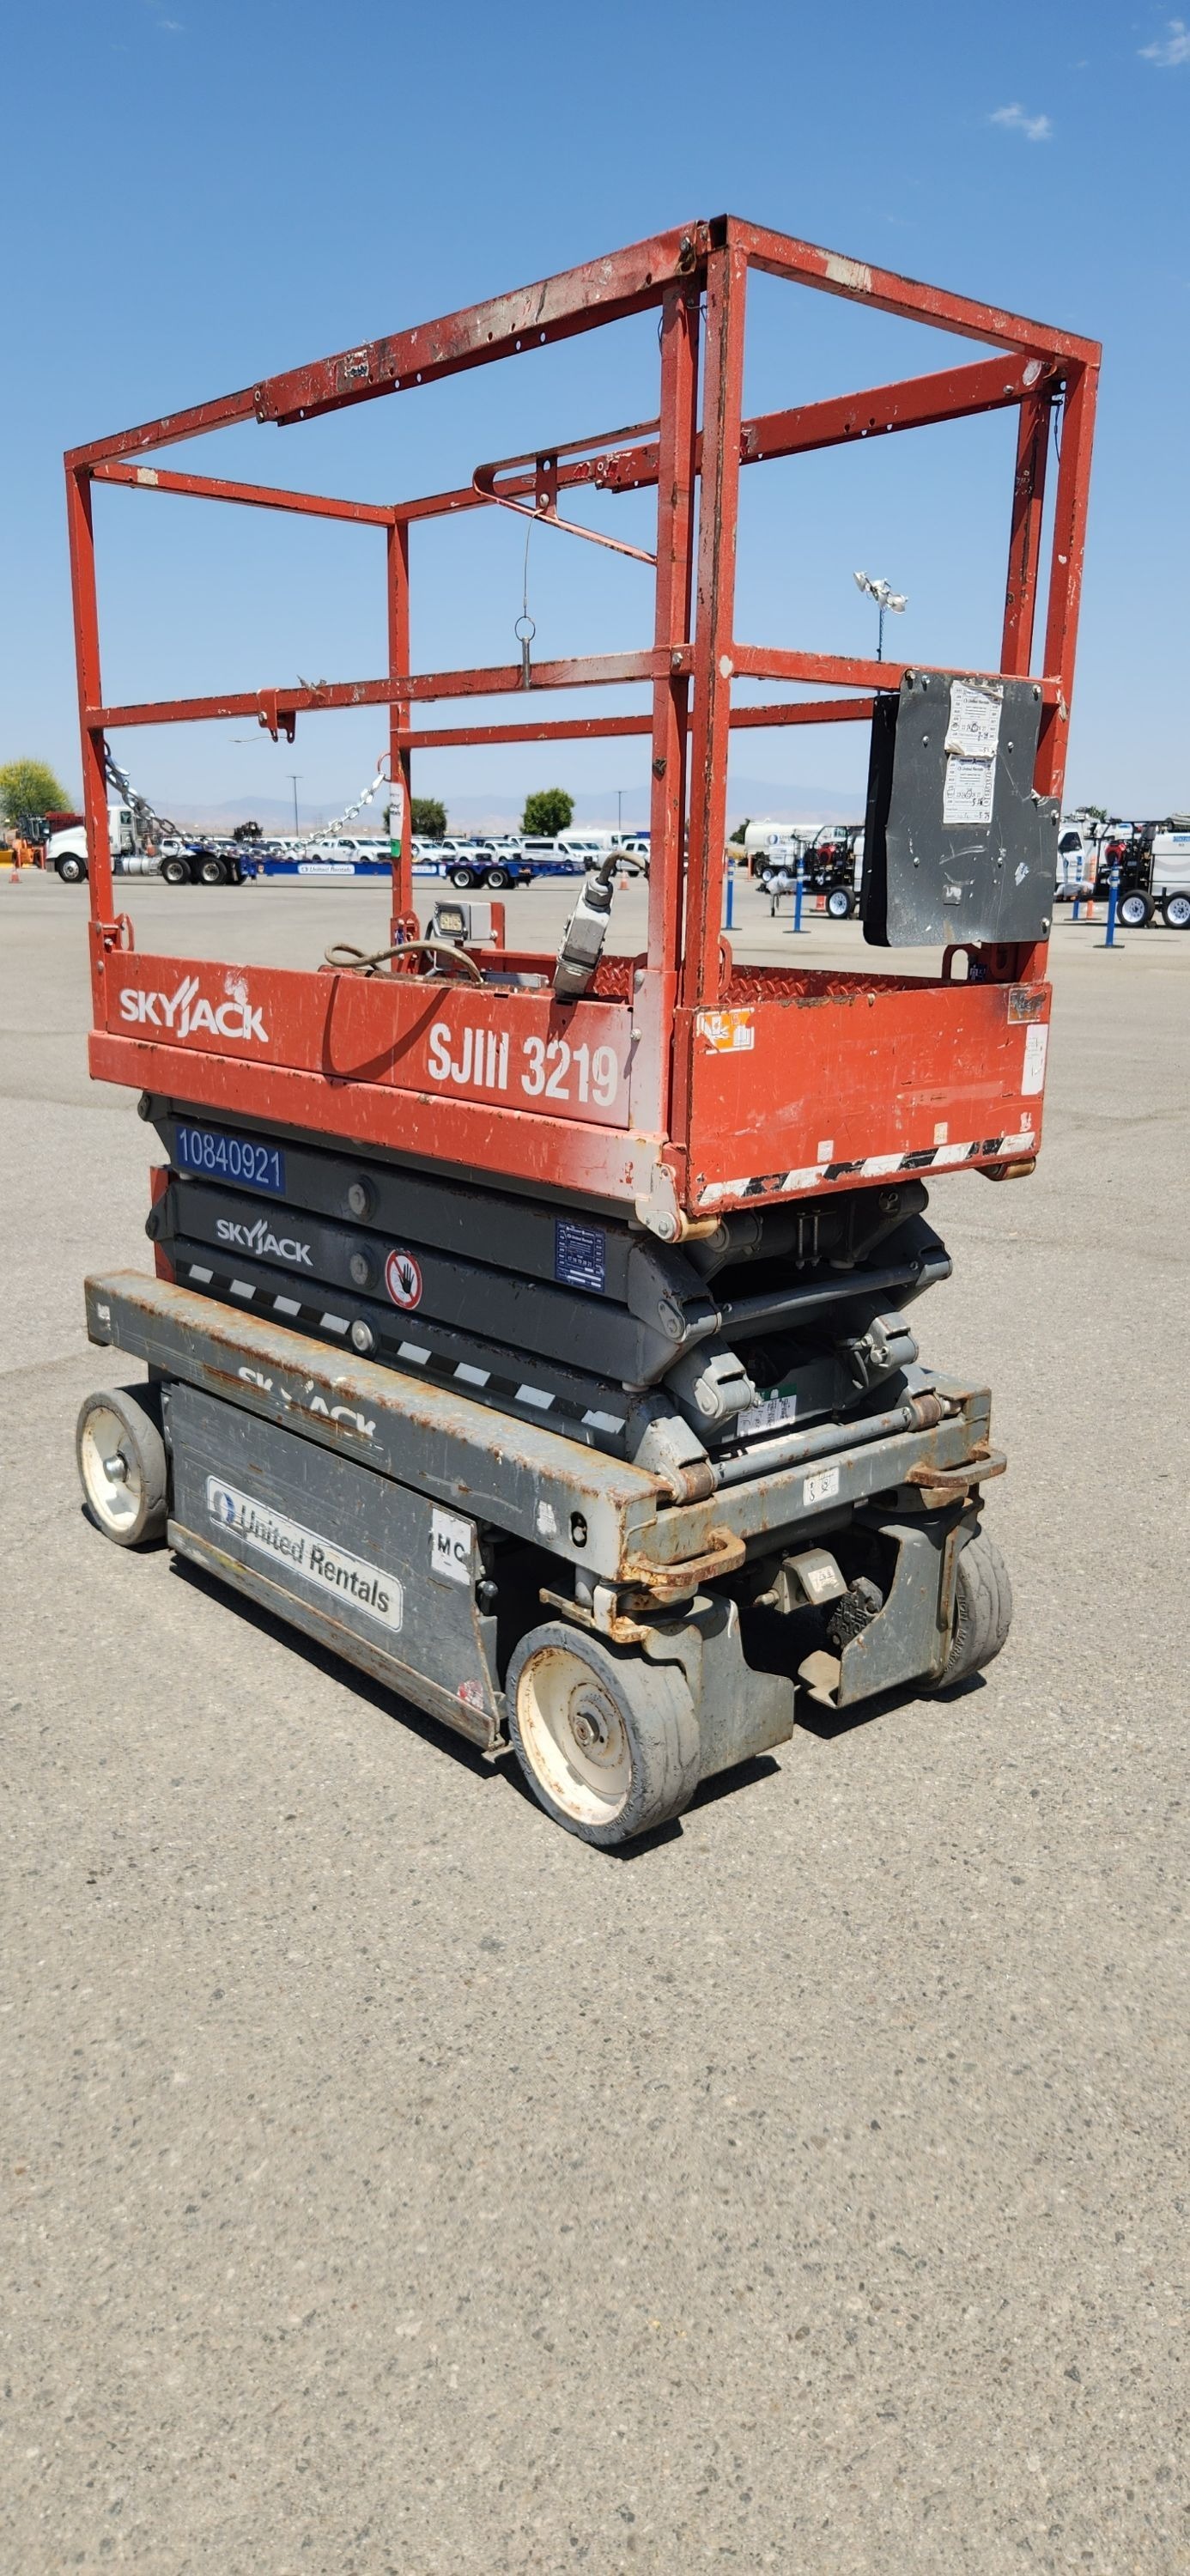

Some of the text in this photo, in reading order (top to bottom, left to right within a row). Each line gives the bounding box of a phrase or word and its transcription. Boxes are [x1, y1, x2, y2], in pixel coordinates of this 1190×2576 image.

[119, 975, 269, 1042] SKYJACK
[521, 1036, 618, 1107] 3219
[179, 1128, 280, 1187] 10840921
[216, 1218, 313, 1267] SKYJACK
[240, 1504, 390, 1613] United Rentals
